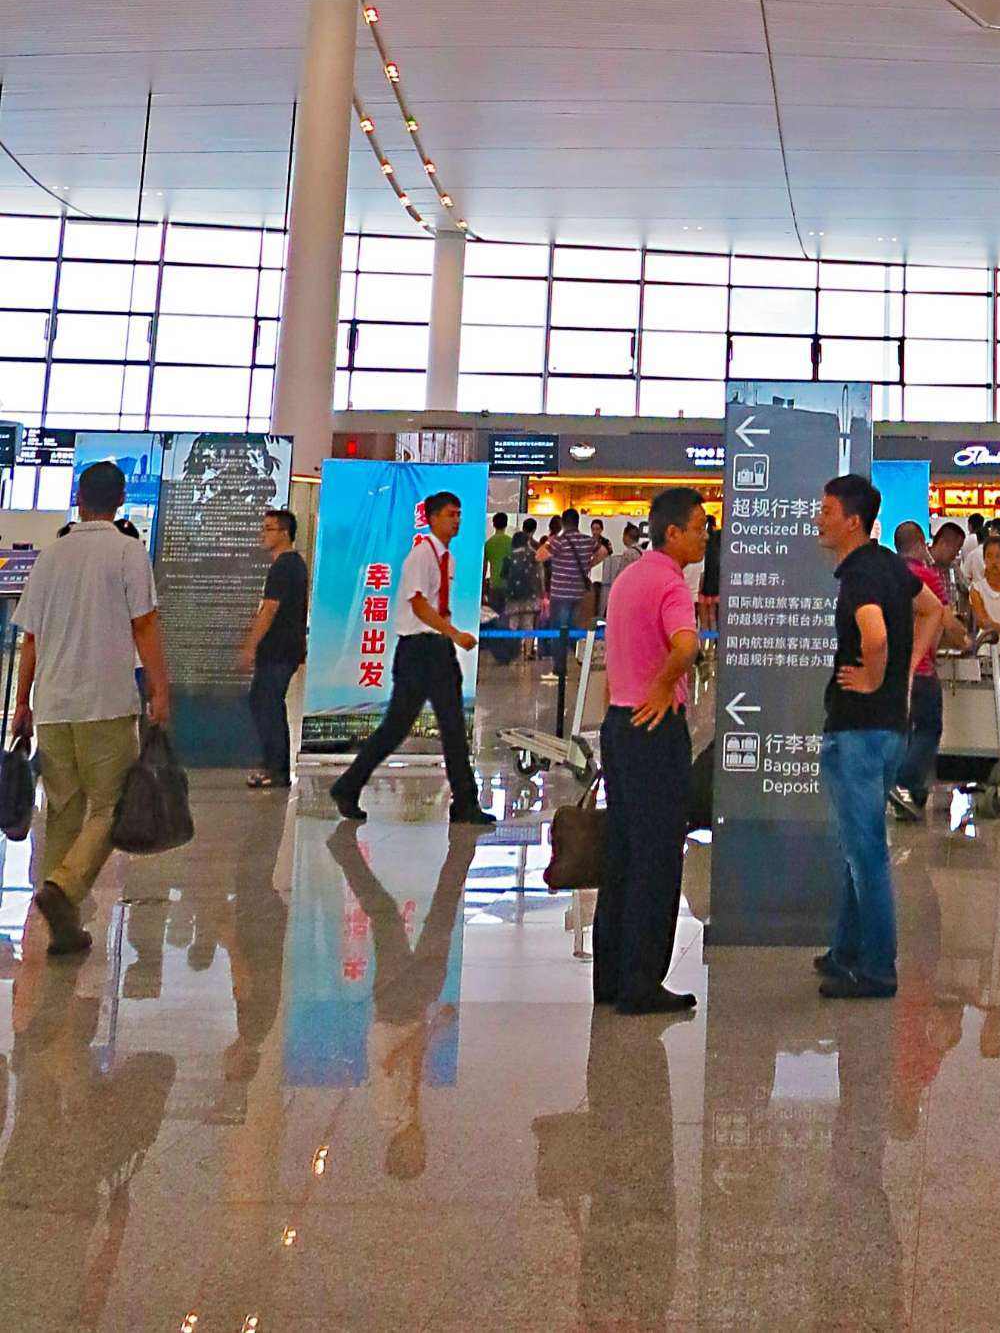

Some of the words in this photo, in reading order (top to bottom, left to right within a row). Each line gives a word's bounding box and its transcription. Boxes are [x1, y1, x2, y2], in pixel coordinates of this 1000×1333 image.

[731, 521, 798, 536] Oversized
[730, 541, 772, 554] Check
[775, 541, 788, 554] in
[358, 562, 391, 690] 幸福出发
[765, 733, 823, 754] 行李寄
[762, 778, 820, 796] Deposit
